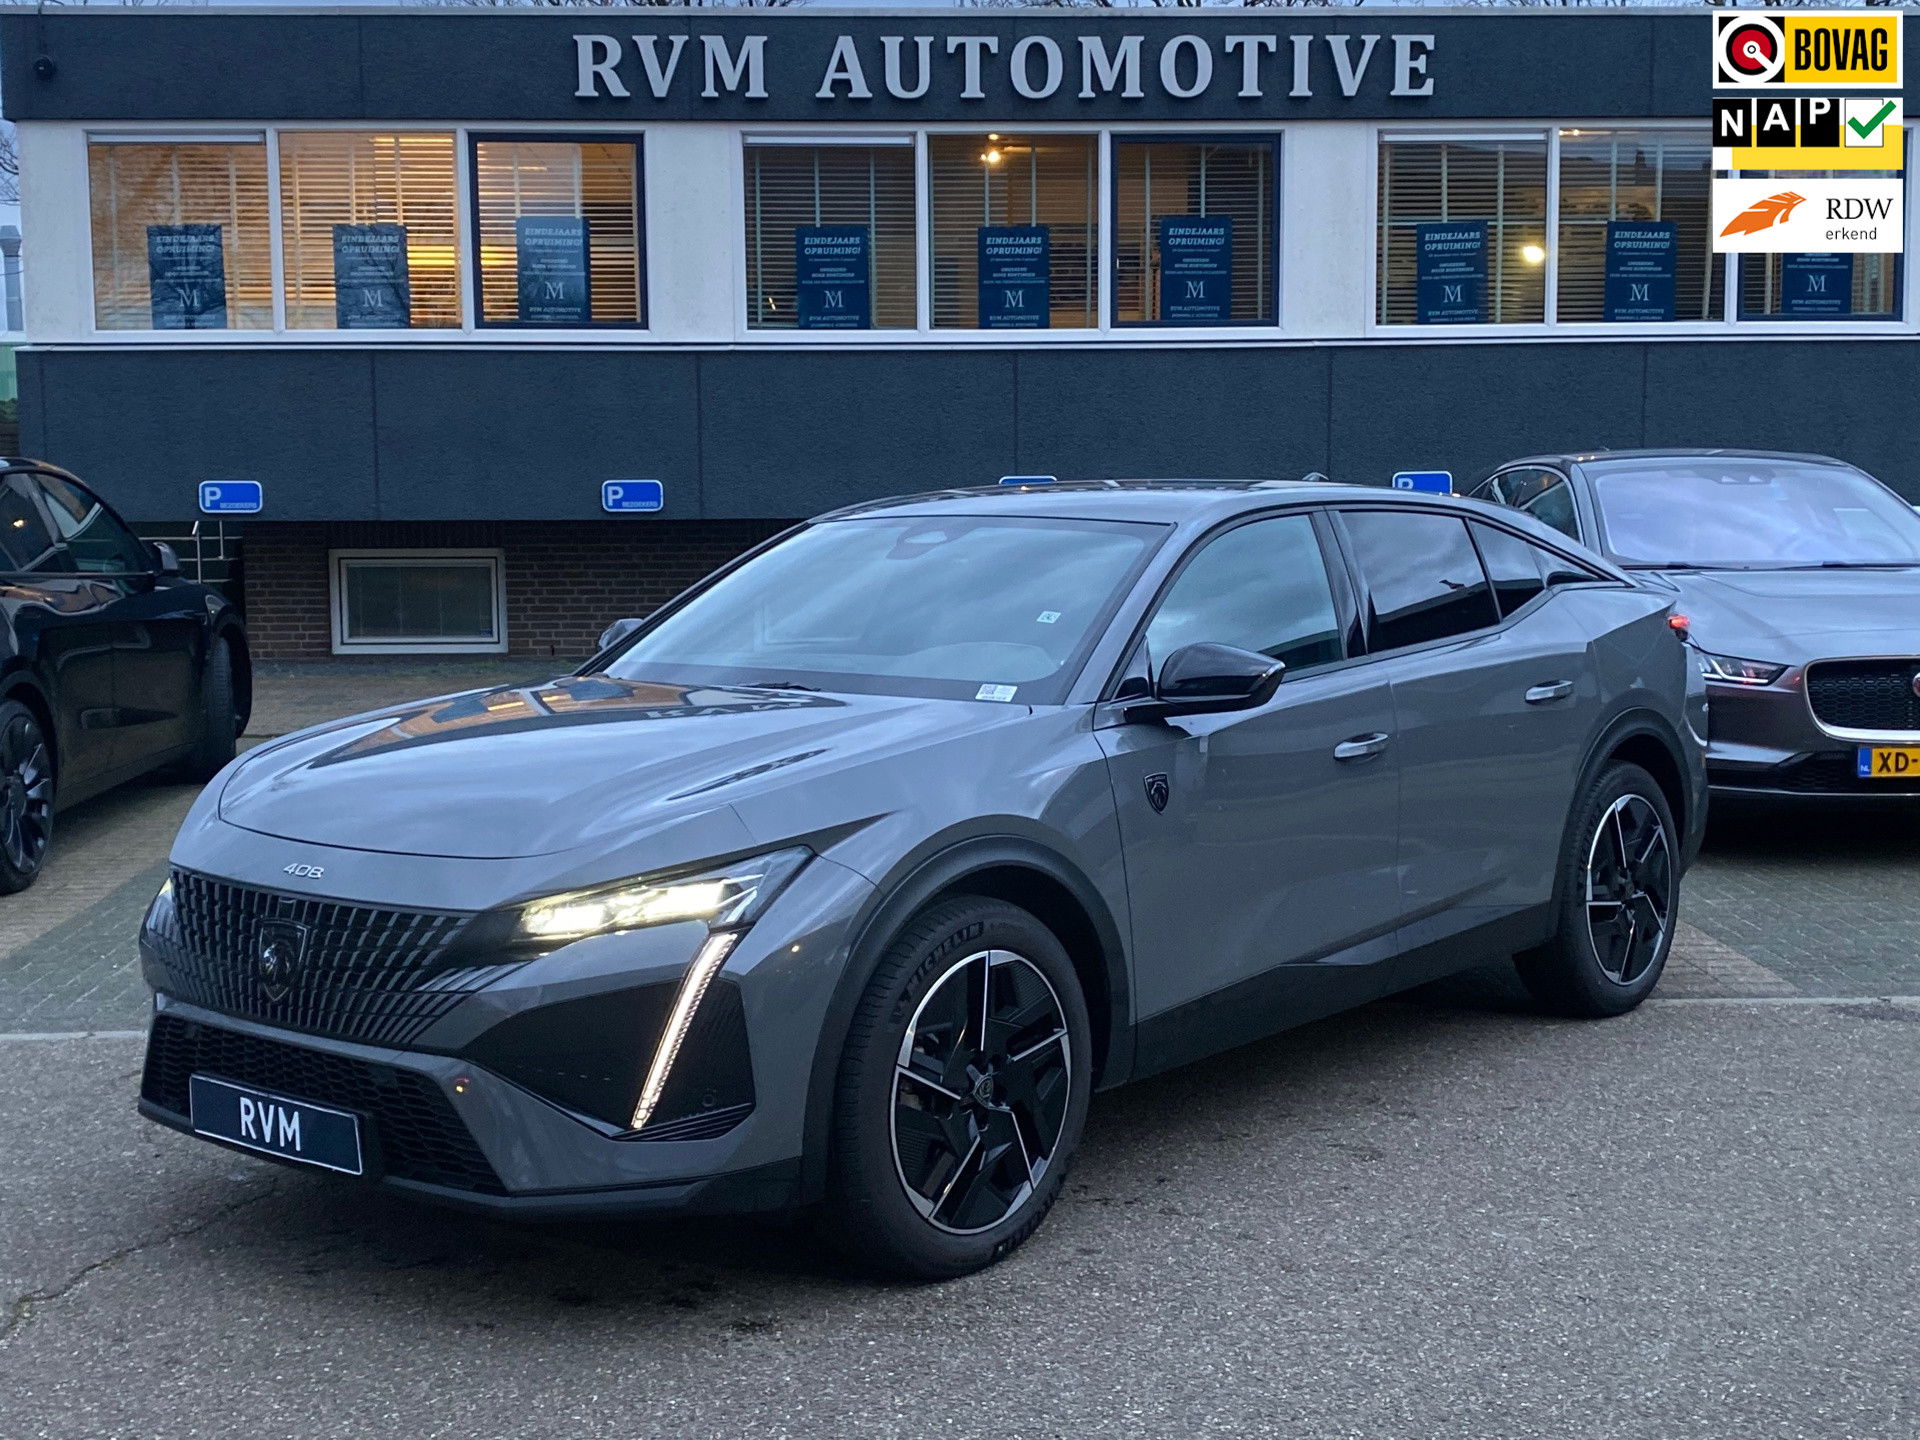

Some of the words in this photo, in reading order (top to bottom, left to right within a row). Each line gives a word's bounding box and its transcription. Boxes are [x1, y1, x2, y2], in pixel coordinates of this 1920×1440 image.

[572, 34, 769, 98] RVM
[814, 34, 1435, 99] AUTOMOTIVE
[1168, 228, 1225, 236] EINDEJAARS
[1424, 232, 1481, 241] EINDEJAARS
[1614, 231, 1671, 239] EINDEJAARS
[804, 237, 860, 245] EINDEJAARS
[986, 237, 1042, 245] EINDEJAARS
[205, 487, 221, 507] P
[607, 486, 624, 506] P
[283, 863, 325, 879] 408
[240, 1096, 301, 1151] RVM
